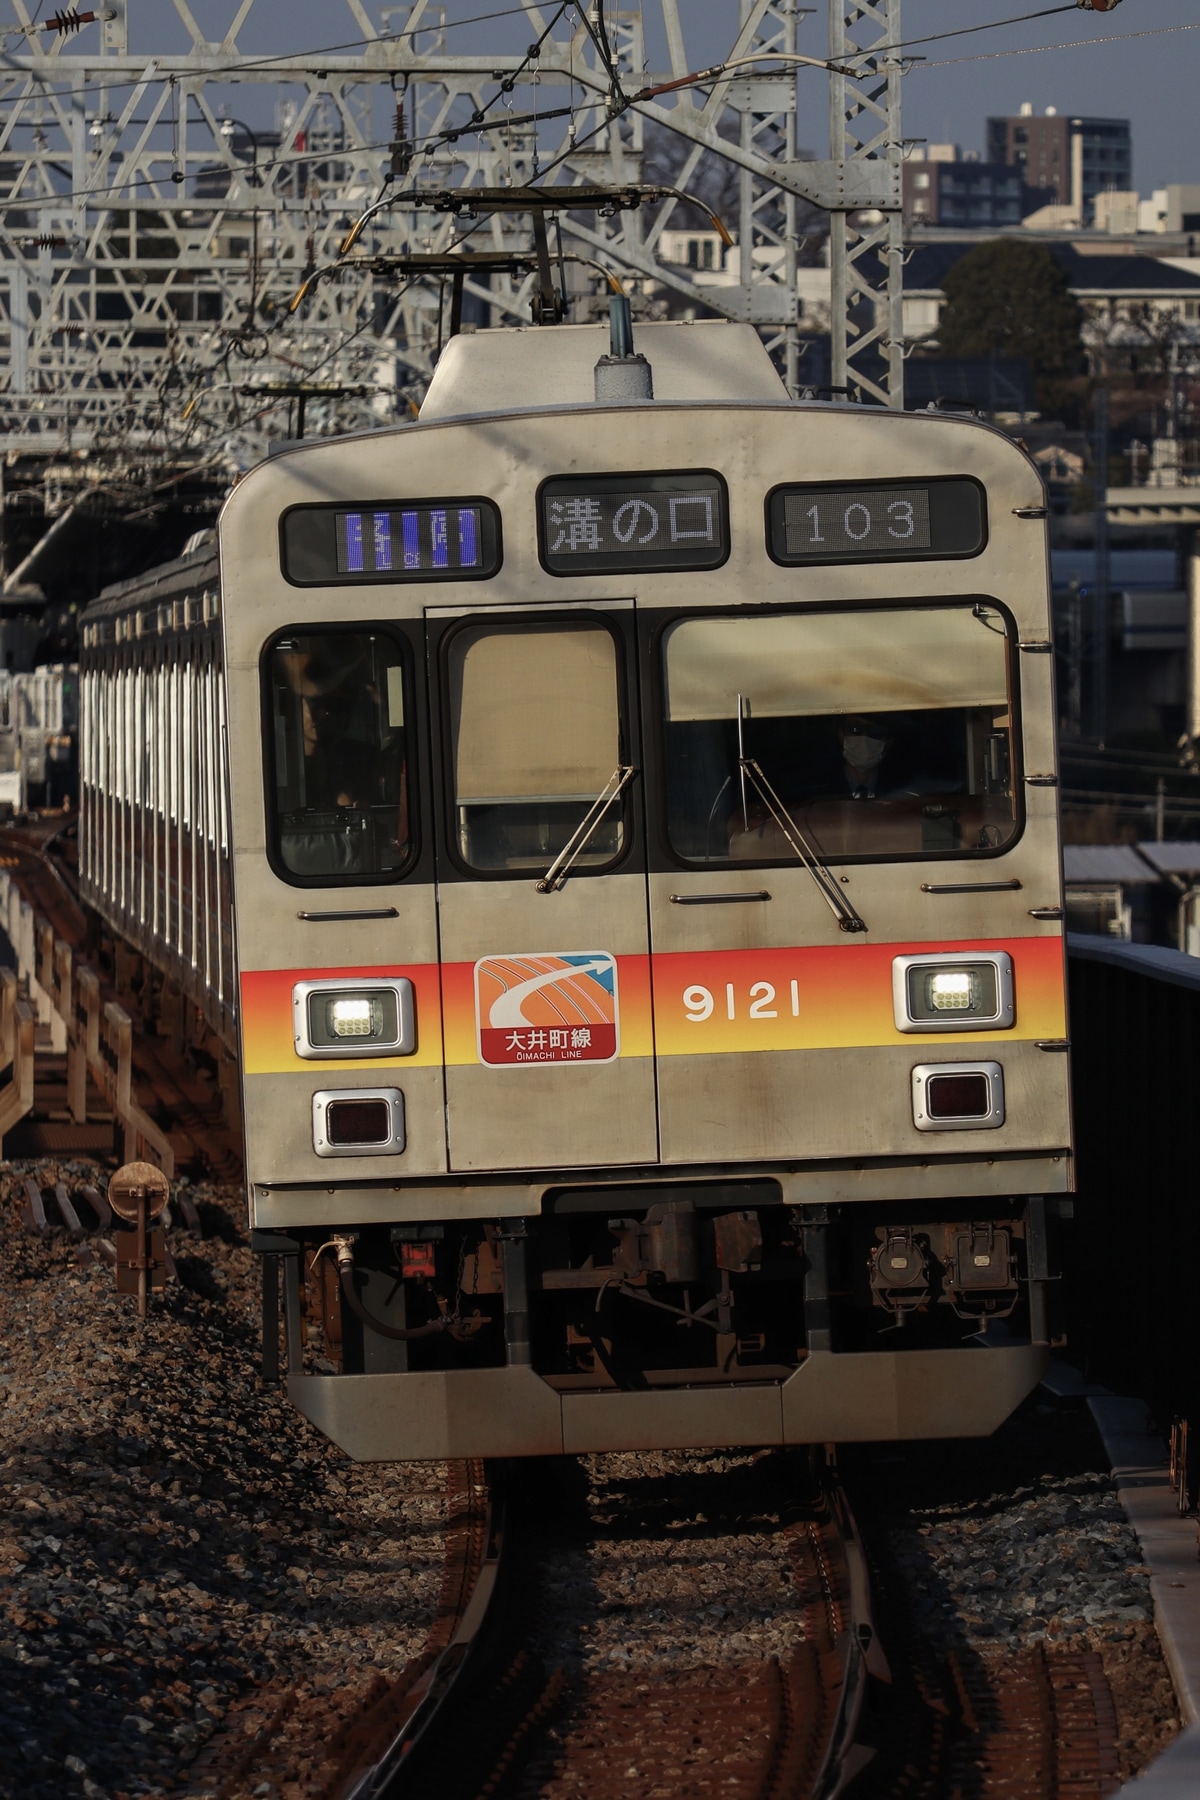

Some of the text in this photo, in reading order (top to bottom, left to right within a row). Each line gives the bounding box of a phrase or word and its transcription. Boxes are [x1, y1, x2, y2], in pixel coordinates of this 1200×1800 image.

[550, 496, 713, 551] 溝の口
[806, 501, 914, 542] 103
[682, 979, 800, 1022] 9121
[505, 1027, 592, 1051] 大井町線
[561, 1050, 582, 1059] LINE
